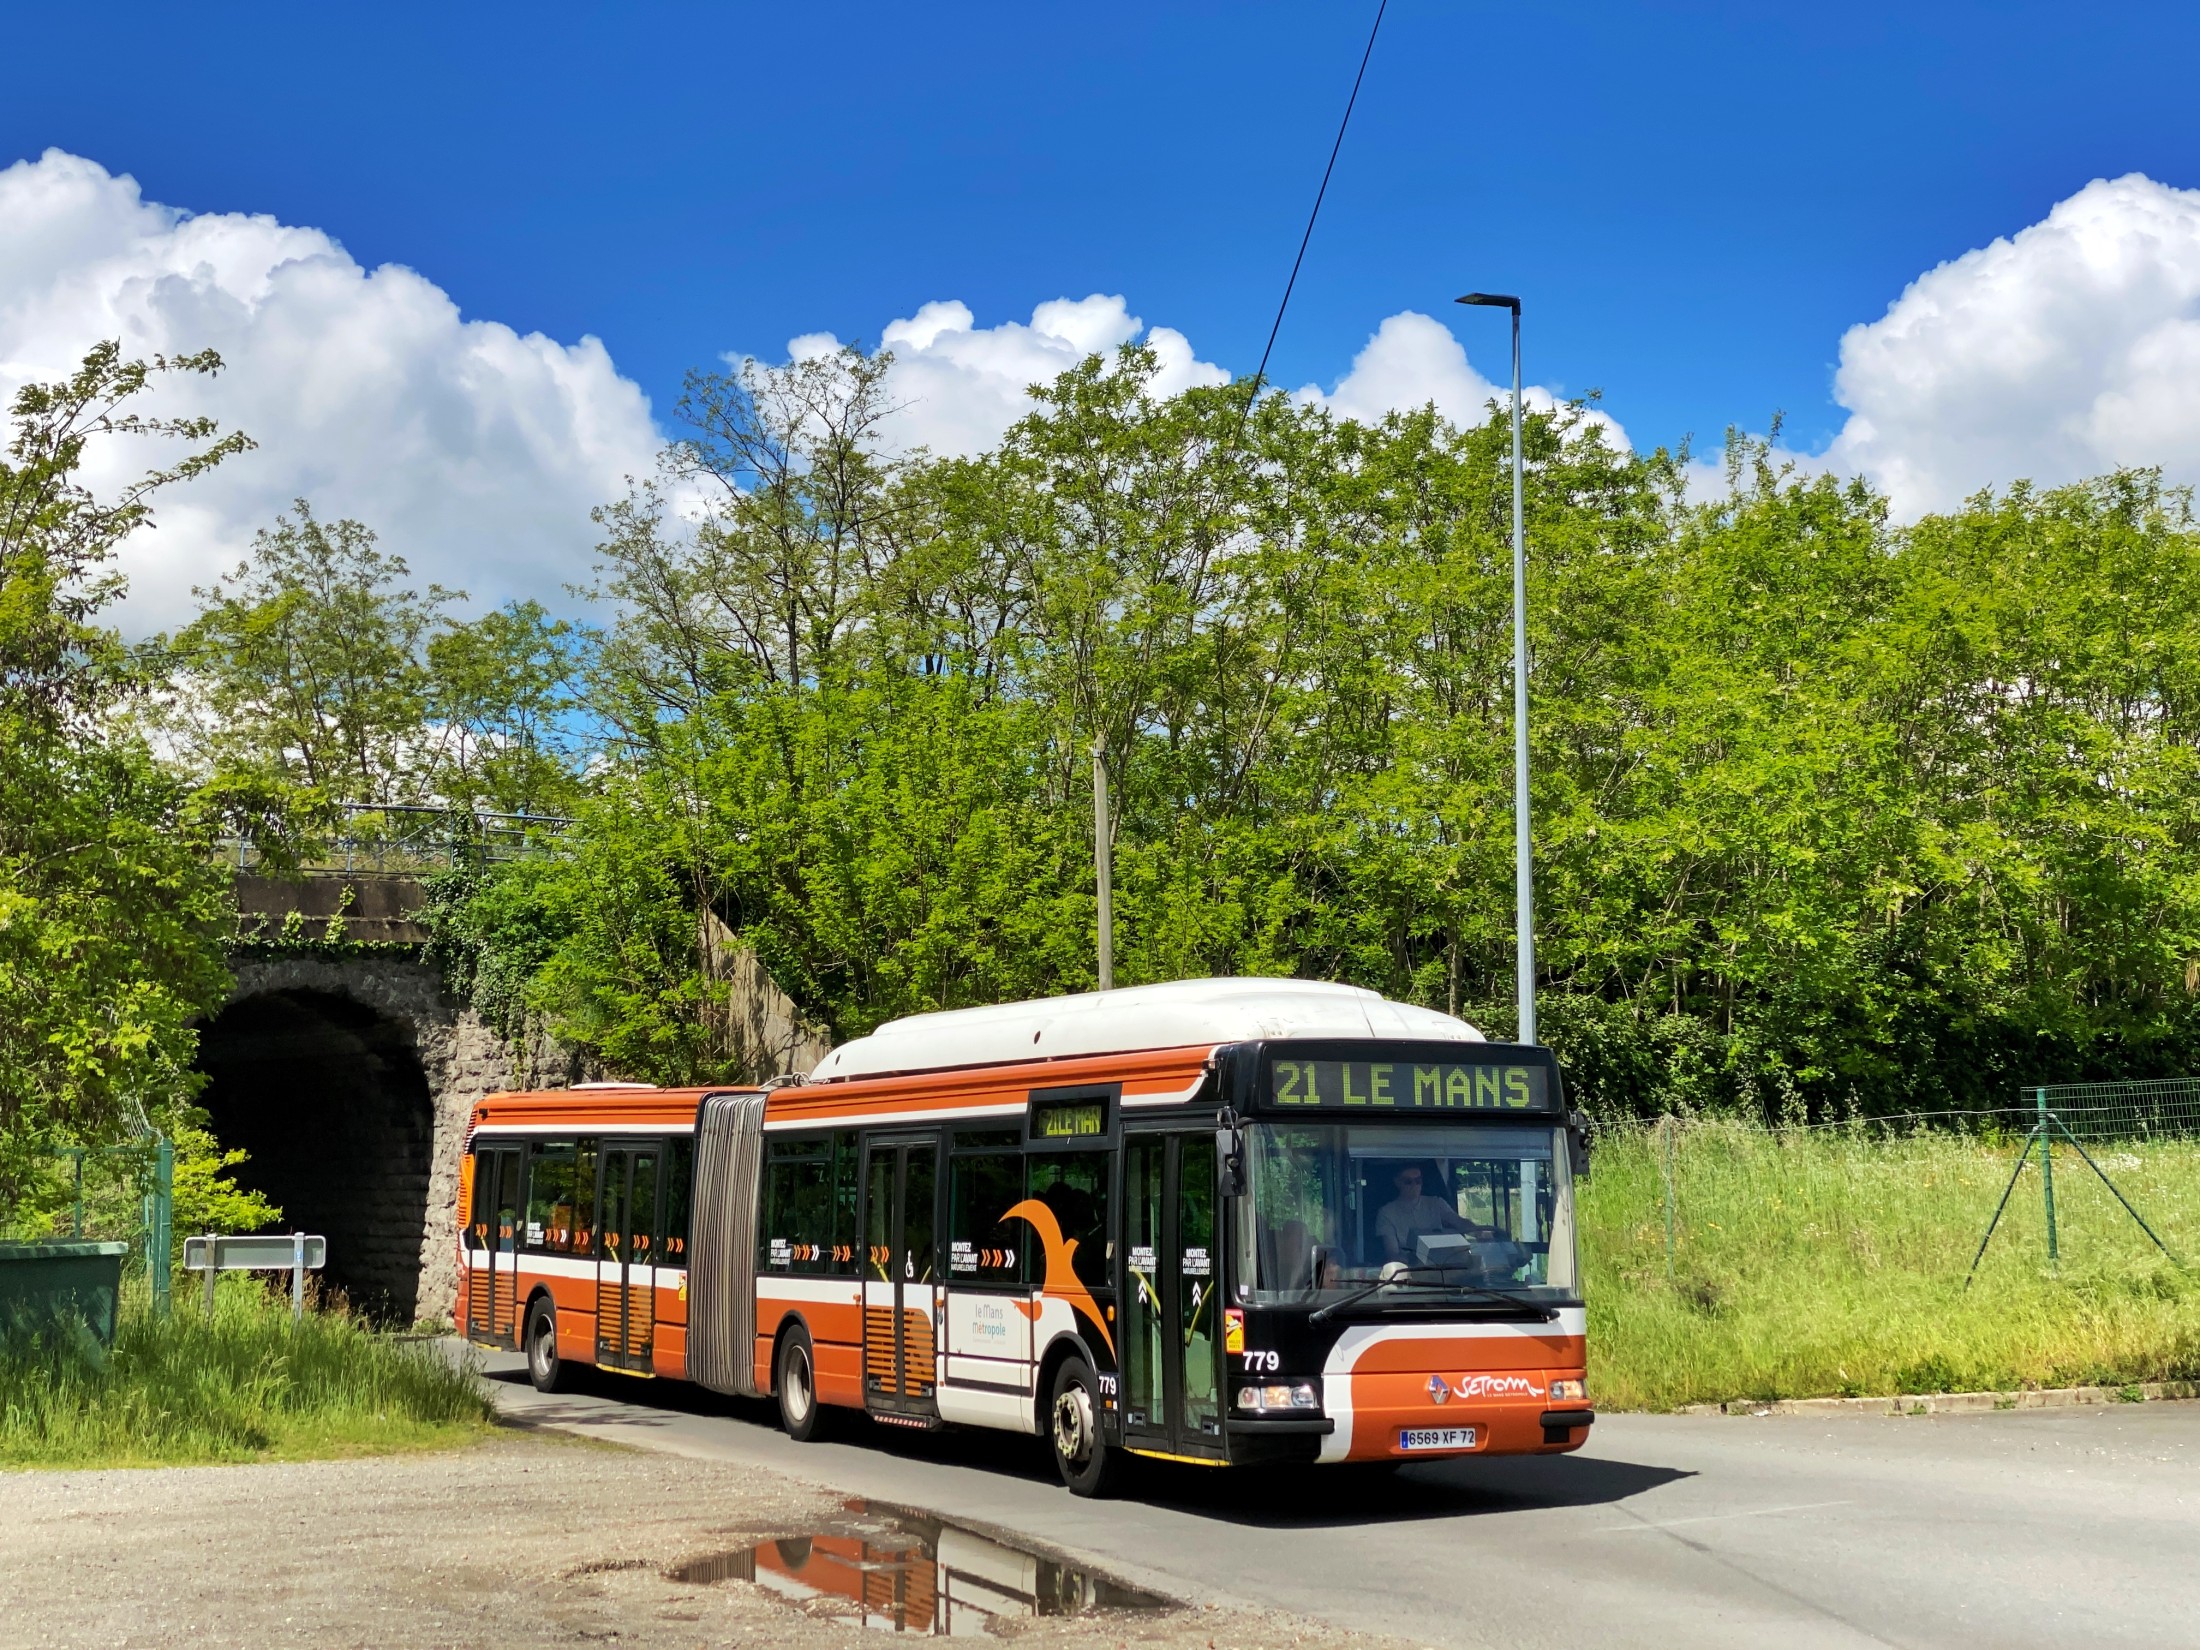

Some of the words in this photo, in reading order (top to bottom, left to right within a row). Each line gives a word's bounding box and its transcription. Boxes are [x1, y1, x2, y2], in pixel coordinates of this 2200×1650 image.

[1276, 1062, 1320, 1104] 21
[1342, 1063, 1395, 1105] LE
[1413, 1065, 1530, 1107] MANS
[951, 1241, 972, 1253] MONTEZ
[1132, 1246, 1153, 1257] MONTEZ
[1185, 1248, 1207, 1258] MONTEZ
[951, 1252, 960, 1264] PAR
[1128, 1255, 1138, 1265] PAR
[1182, 1257, 1192, 1267] PAR
[1242, 1350, 1280, 1371] 779
[1098, 1375, 1117, 1395] 779
[1408, 1431, 1439, 1446] 6569
[1443, 1430, 1457, 1445] XF
[1460, 1430, 1475, 1444] 72
